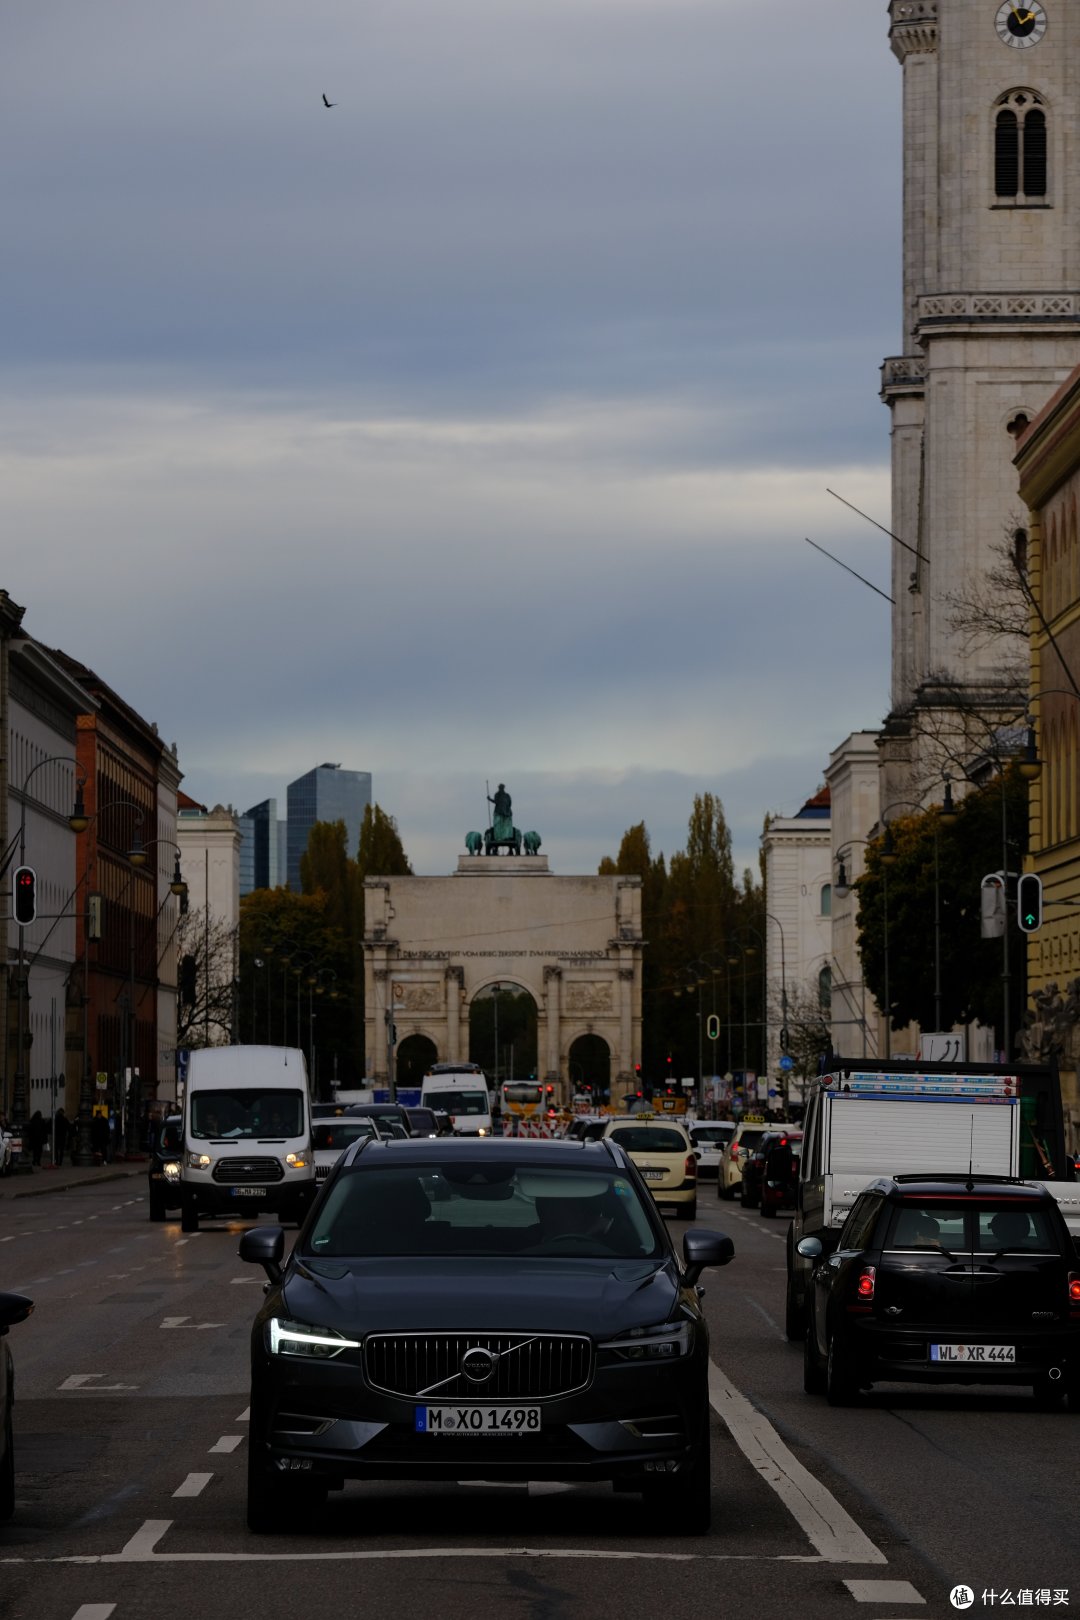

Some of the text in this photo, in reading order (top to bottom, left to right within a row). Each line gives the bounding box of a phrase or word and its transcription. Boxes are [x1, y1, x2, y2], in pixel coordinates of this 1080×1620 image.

[940, 1346, 1014, 1361] WL XR 444
[429, 1409, 539, 1429] M XO 1498
